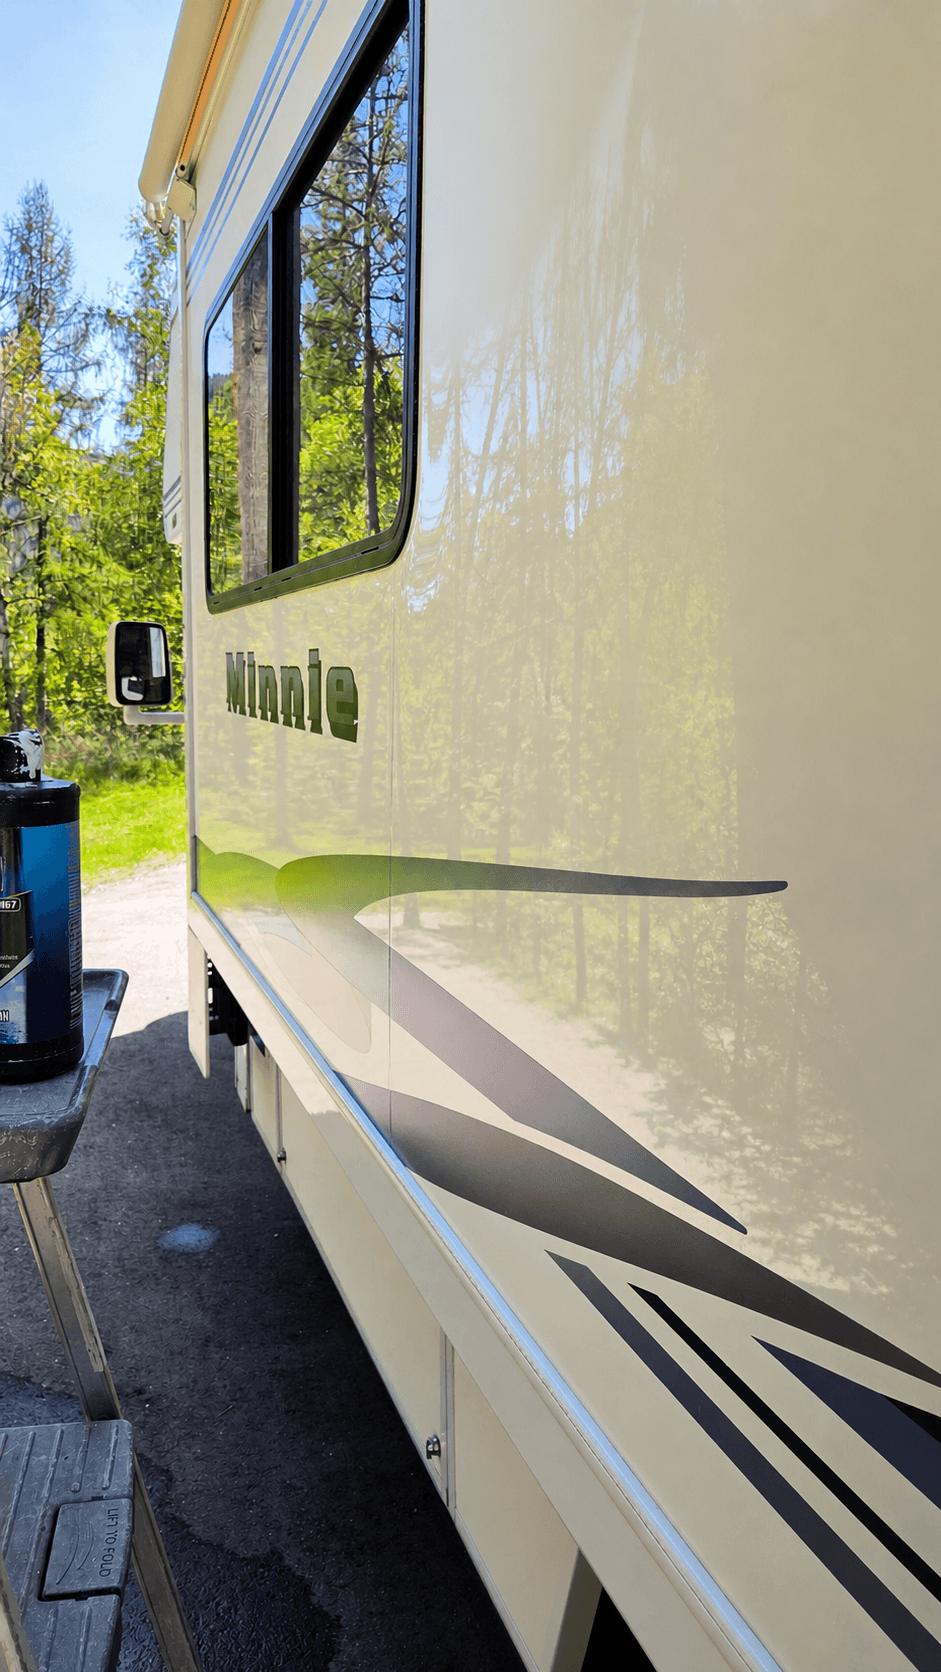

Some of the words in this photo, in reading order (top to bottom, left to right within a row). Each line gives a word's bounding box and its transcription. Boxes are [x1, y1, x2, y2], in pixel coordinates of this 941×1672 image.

[225, 648, 358, 743] Minnie
[0, 900, 17, 909] 167
[107, 1507, 119, 1527] LIFT
[105, 1530, 118, 1545] TO
[99, 1547, 115, 1577] FOLD
